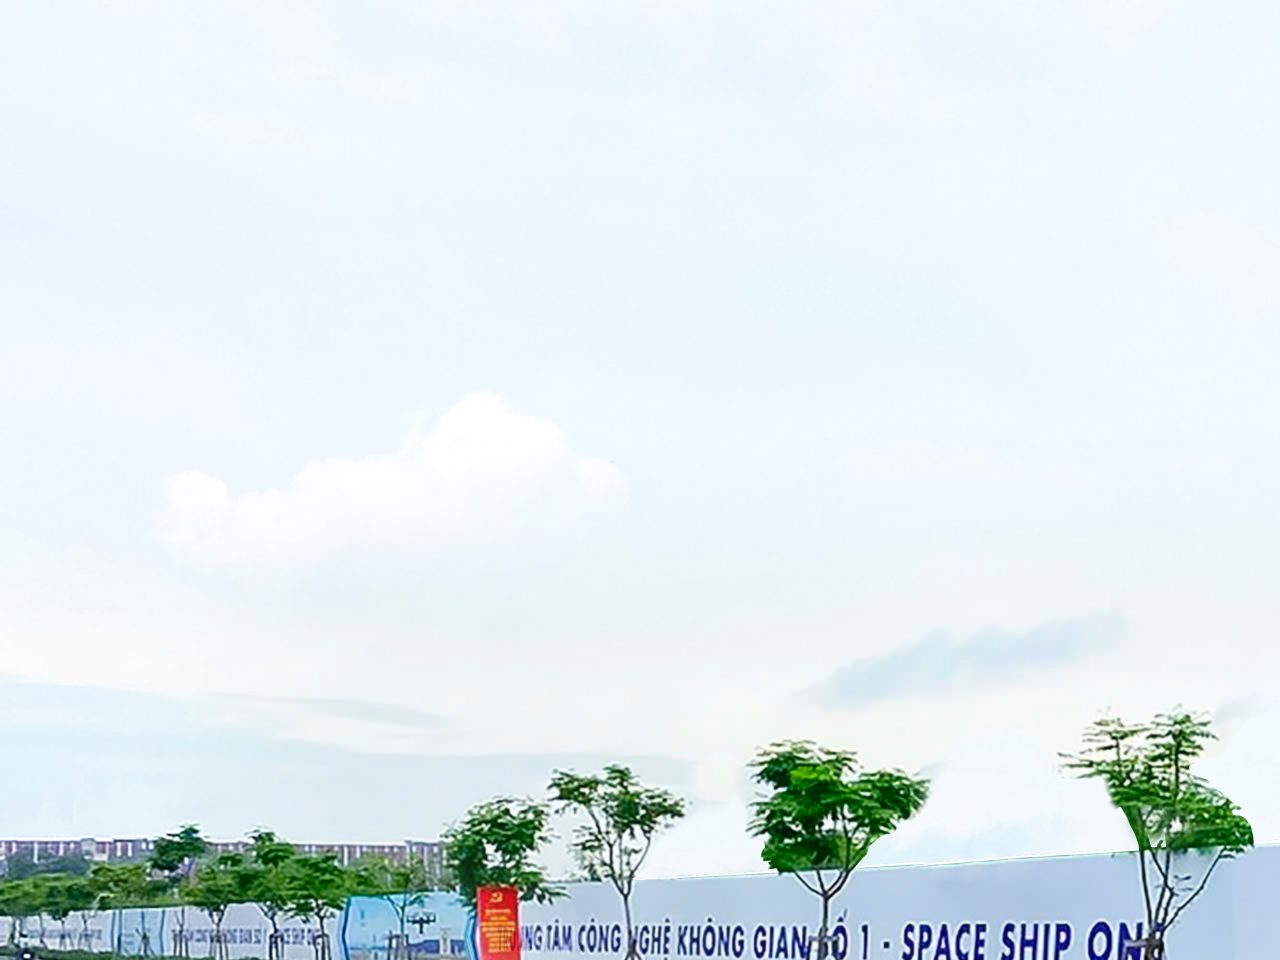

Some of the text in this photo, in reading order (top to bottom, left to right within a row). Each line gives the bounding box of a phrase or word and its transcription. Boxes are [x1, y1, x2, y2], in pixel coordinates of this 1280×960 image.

[547, 918, 572, 952] TÂM
[578, 917, 621, 953] CÔNG
[677, 917, 745, 958] KHÔNG
[753, 925, 808, 960] GIAN
[862, 924, 868, 960] 1
